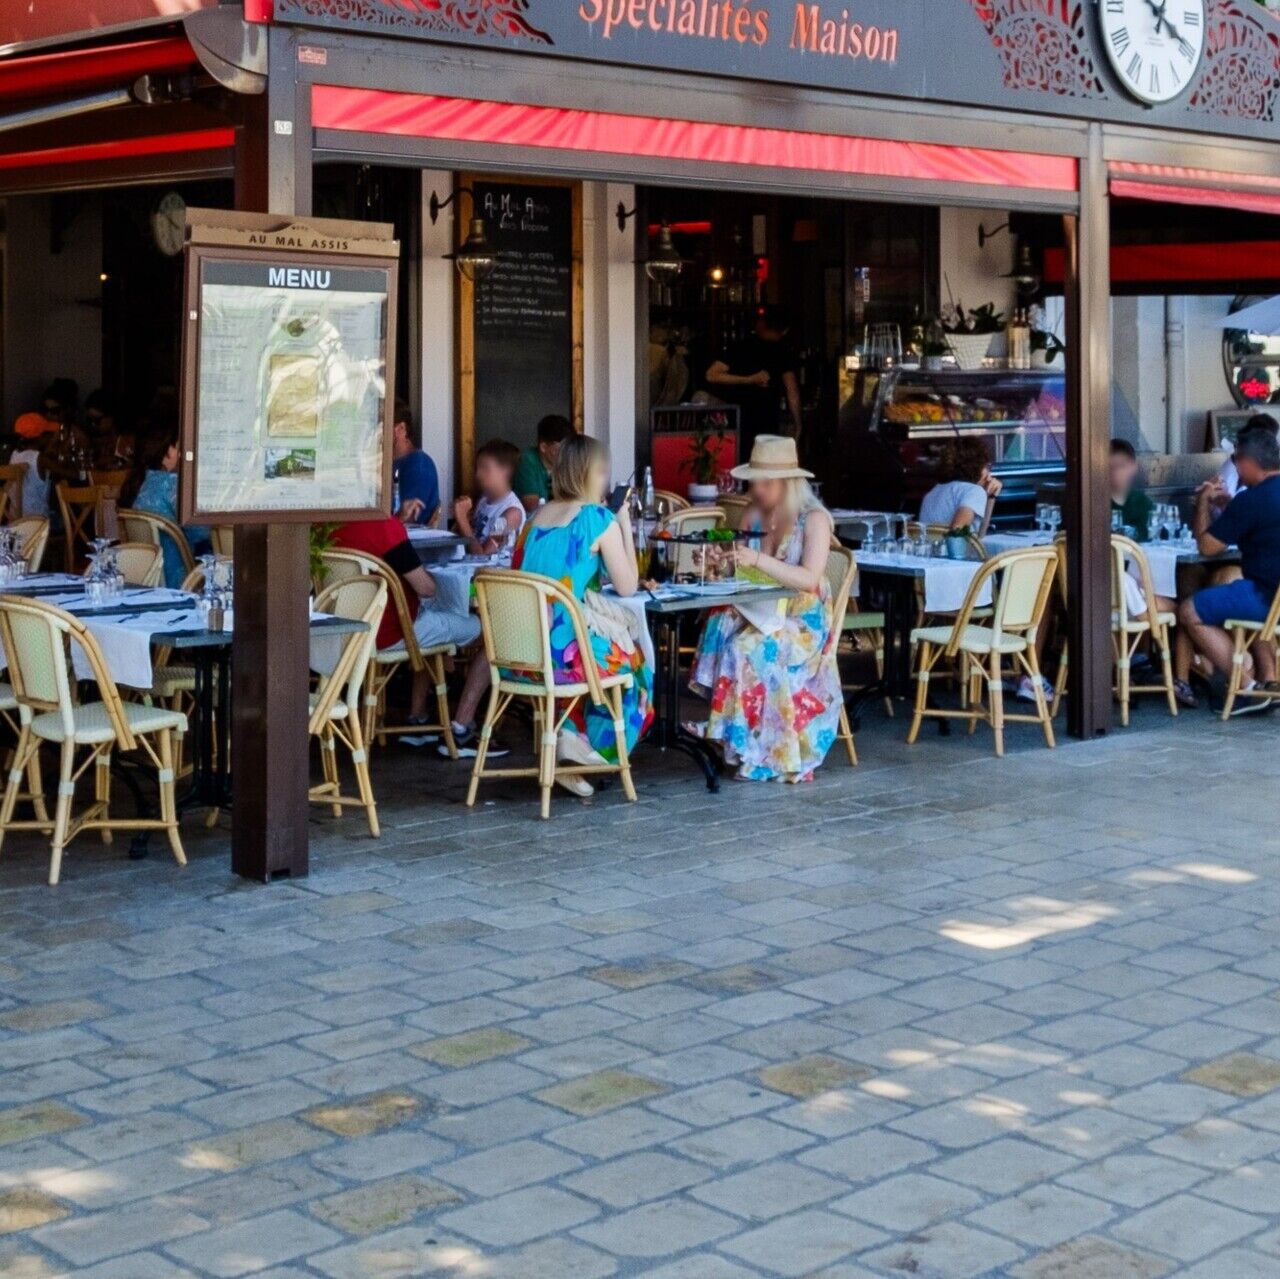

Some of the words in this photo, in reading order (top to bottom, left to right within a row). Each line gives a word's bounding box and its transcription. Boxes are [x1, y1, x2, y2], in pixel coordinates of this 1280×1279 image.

[789, 1, 899, 63] Maison
[248, 234, 267, 245] AU
[275, 236, 303, 247] MAL
[311, 239, 349, 250] ASSIS
[268, 267, 331, 289] MENU
